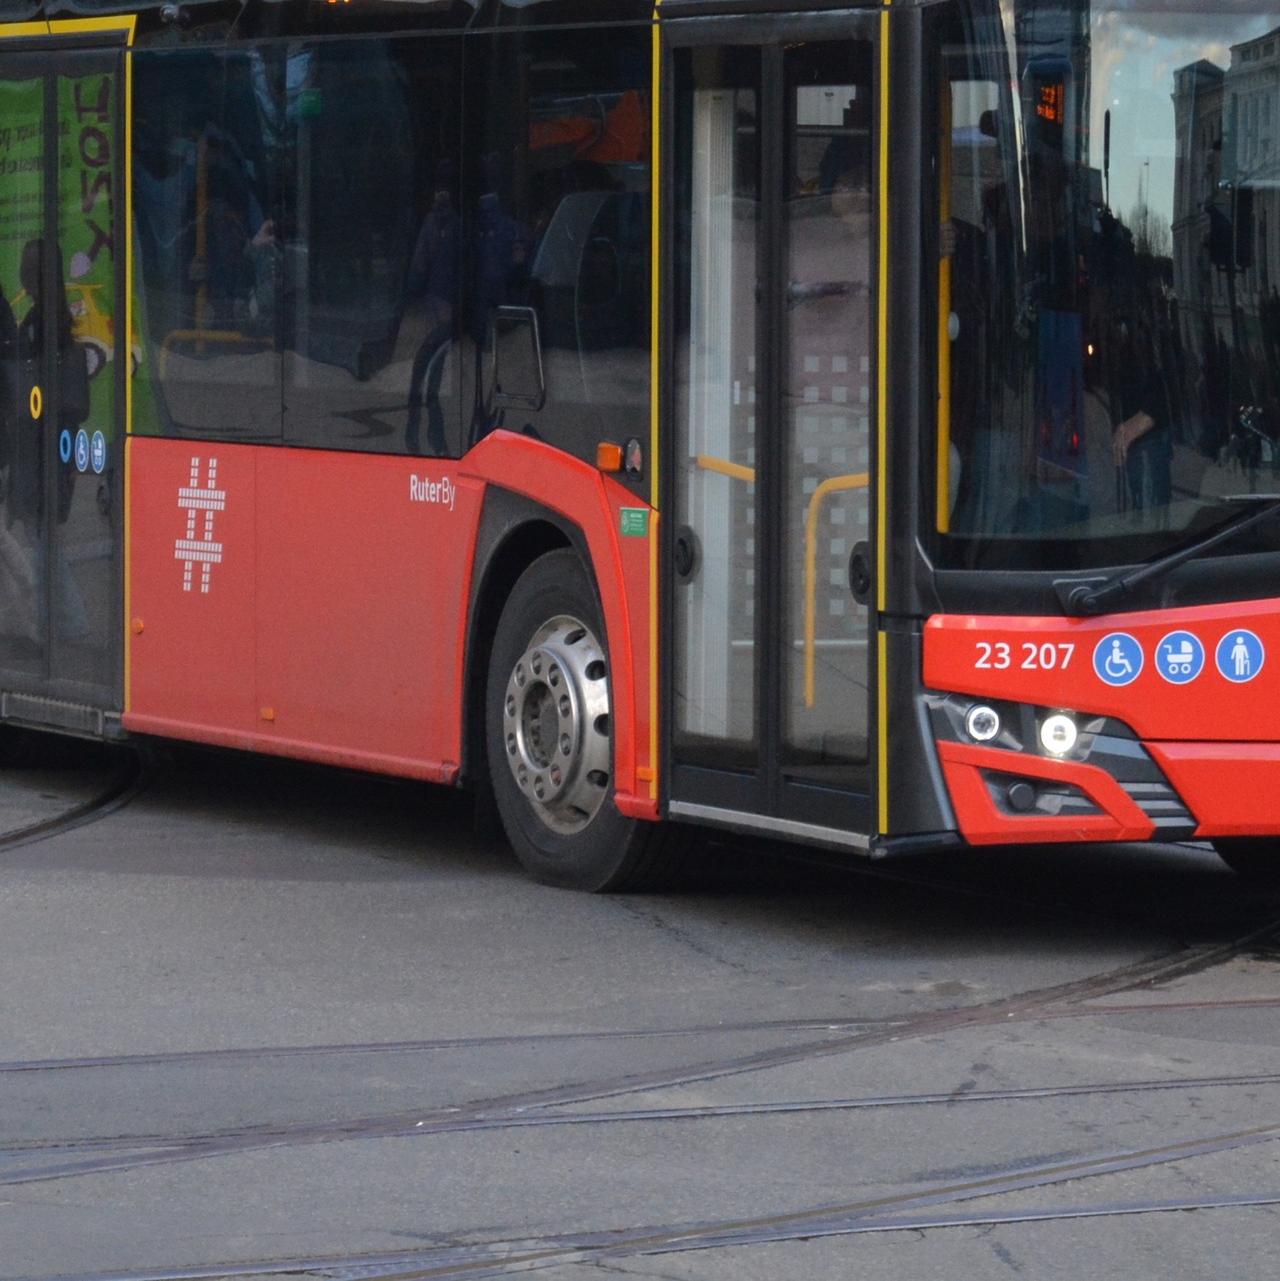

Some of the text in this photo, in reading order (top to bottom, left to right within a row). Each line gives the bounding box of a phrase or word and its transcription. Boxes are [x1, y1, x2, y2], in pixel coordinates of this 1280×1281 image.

[410, 474, 456, 512] RuterBy
[974, 642, 1075, 669] 23 207
